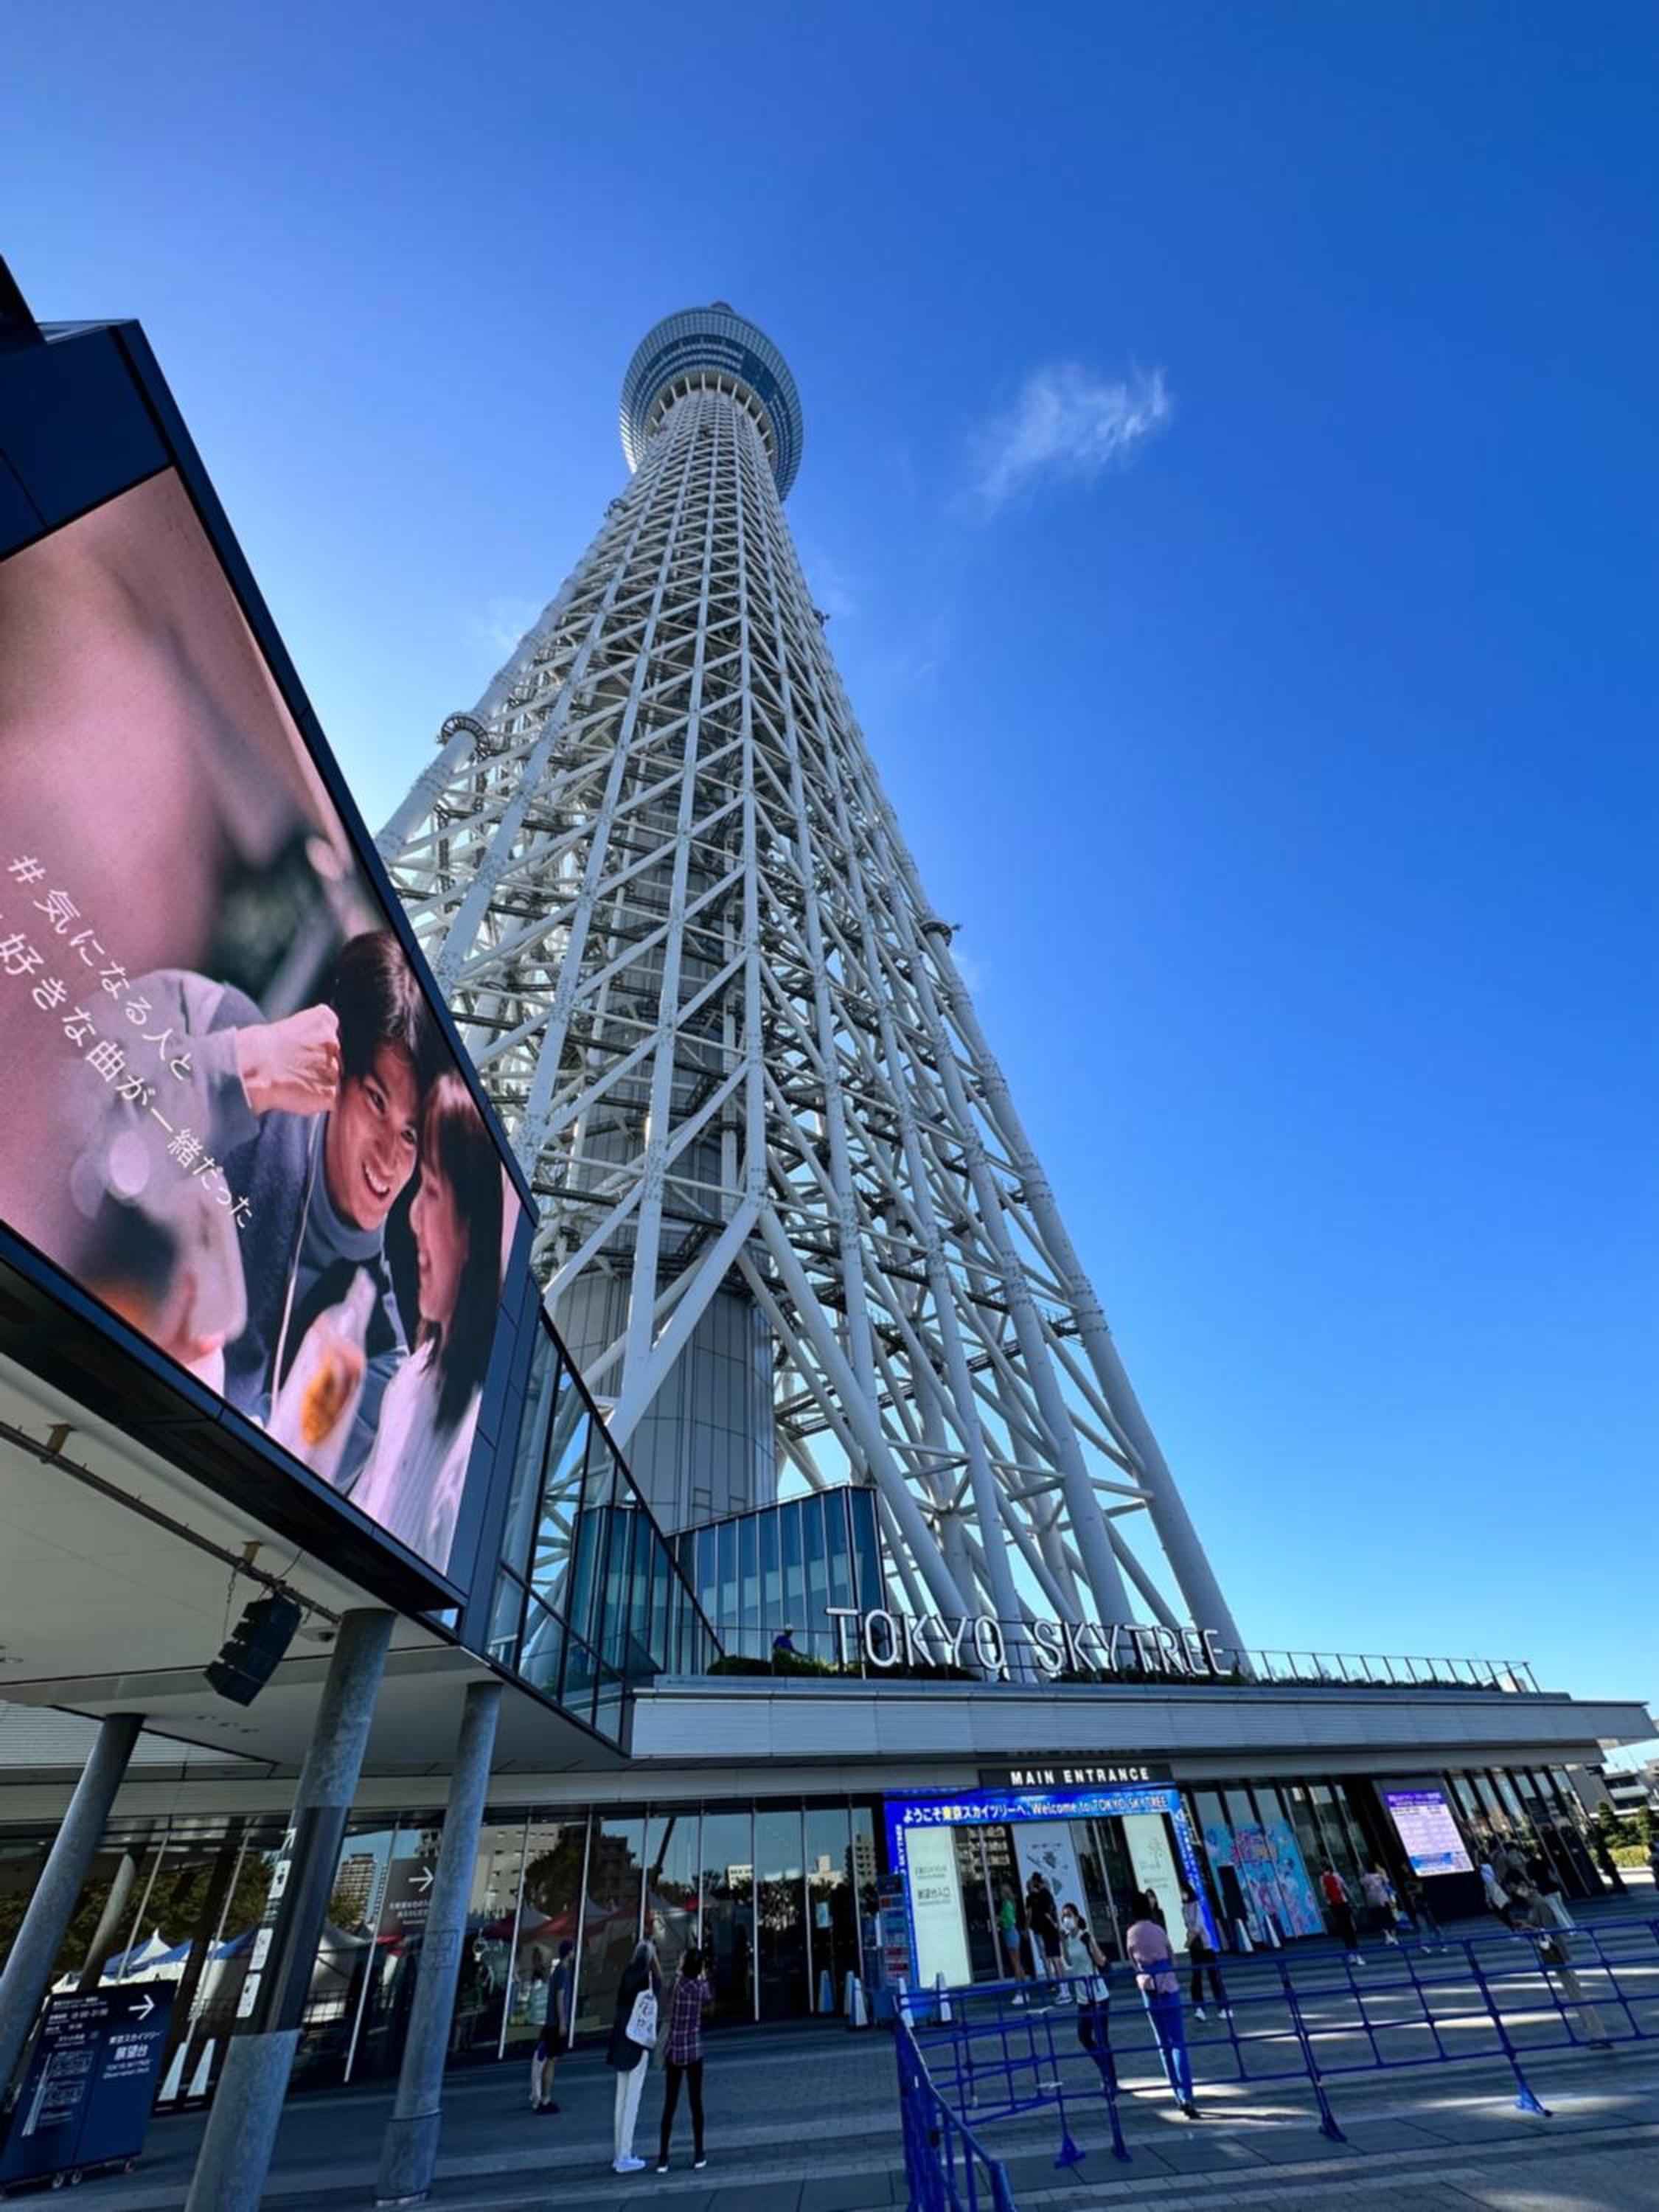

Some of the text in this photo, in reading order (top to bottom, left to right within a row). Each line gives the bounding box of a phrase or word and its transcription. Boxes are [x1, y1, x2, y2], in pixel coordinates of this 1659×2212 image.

[826, 1607, 1234, 1676] TOKYO SKYTREE
[1010, 1767, 1150, 1786] MAIN ENTRANCE
[1032, 1801, 1077, 1817] Welcome
